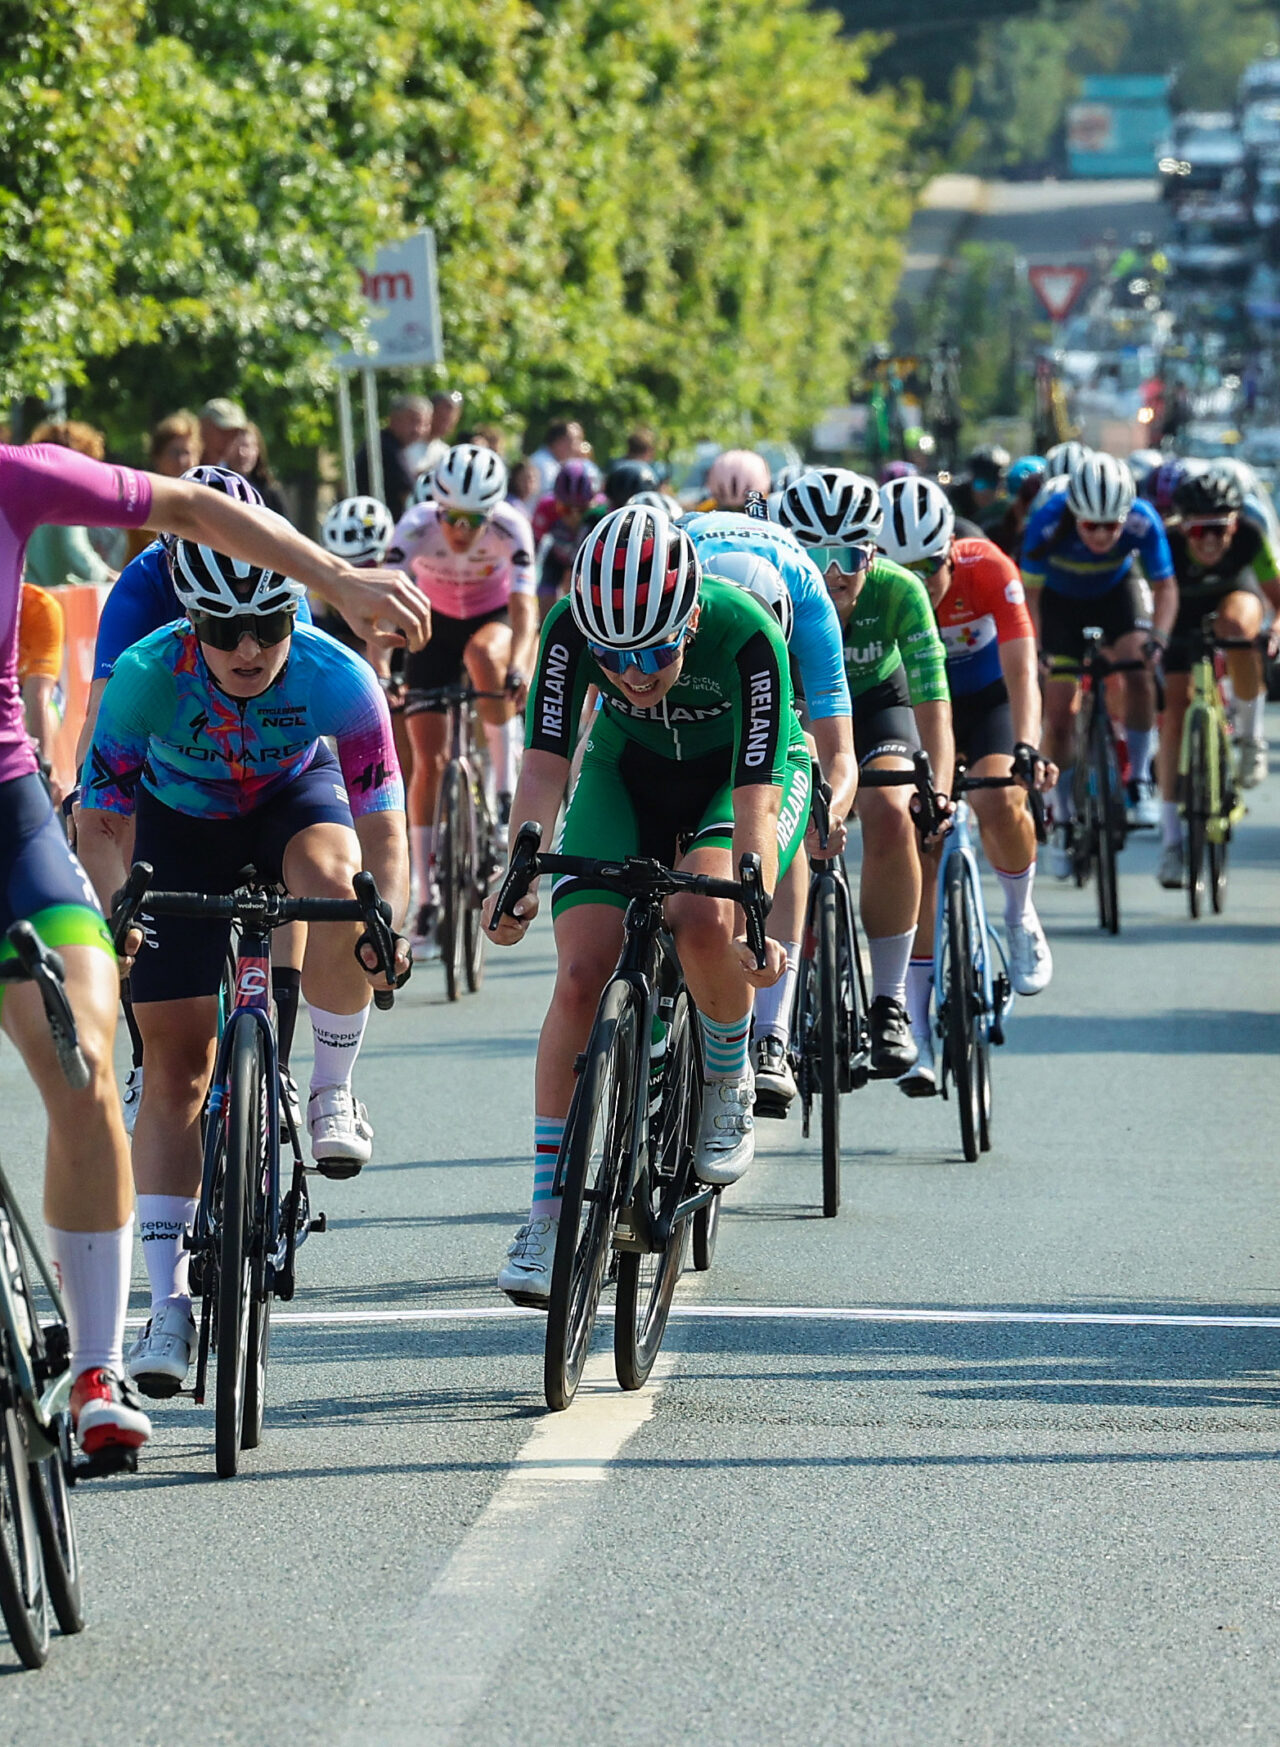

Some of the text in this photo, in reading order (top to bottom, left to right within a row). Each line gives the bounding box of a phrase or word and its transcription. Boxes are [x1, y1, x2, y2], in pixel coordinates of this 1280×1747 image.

[541, 643, 570, 738] IRELAND
[262, 717, 307, 728] NCL
[744, 669, 770, 767] IRELAND
[776, 770, 809, 851] IRELAND
[238, 902, 265, 910] wahoo
[141, 912, 160, 949] AAP
[317, 1036, 358, 1048] wahoo
